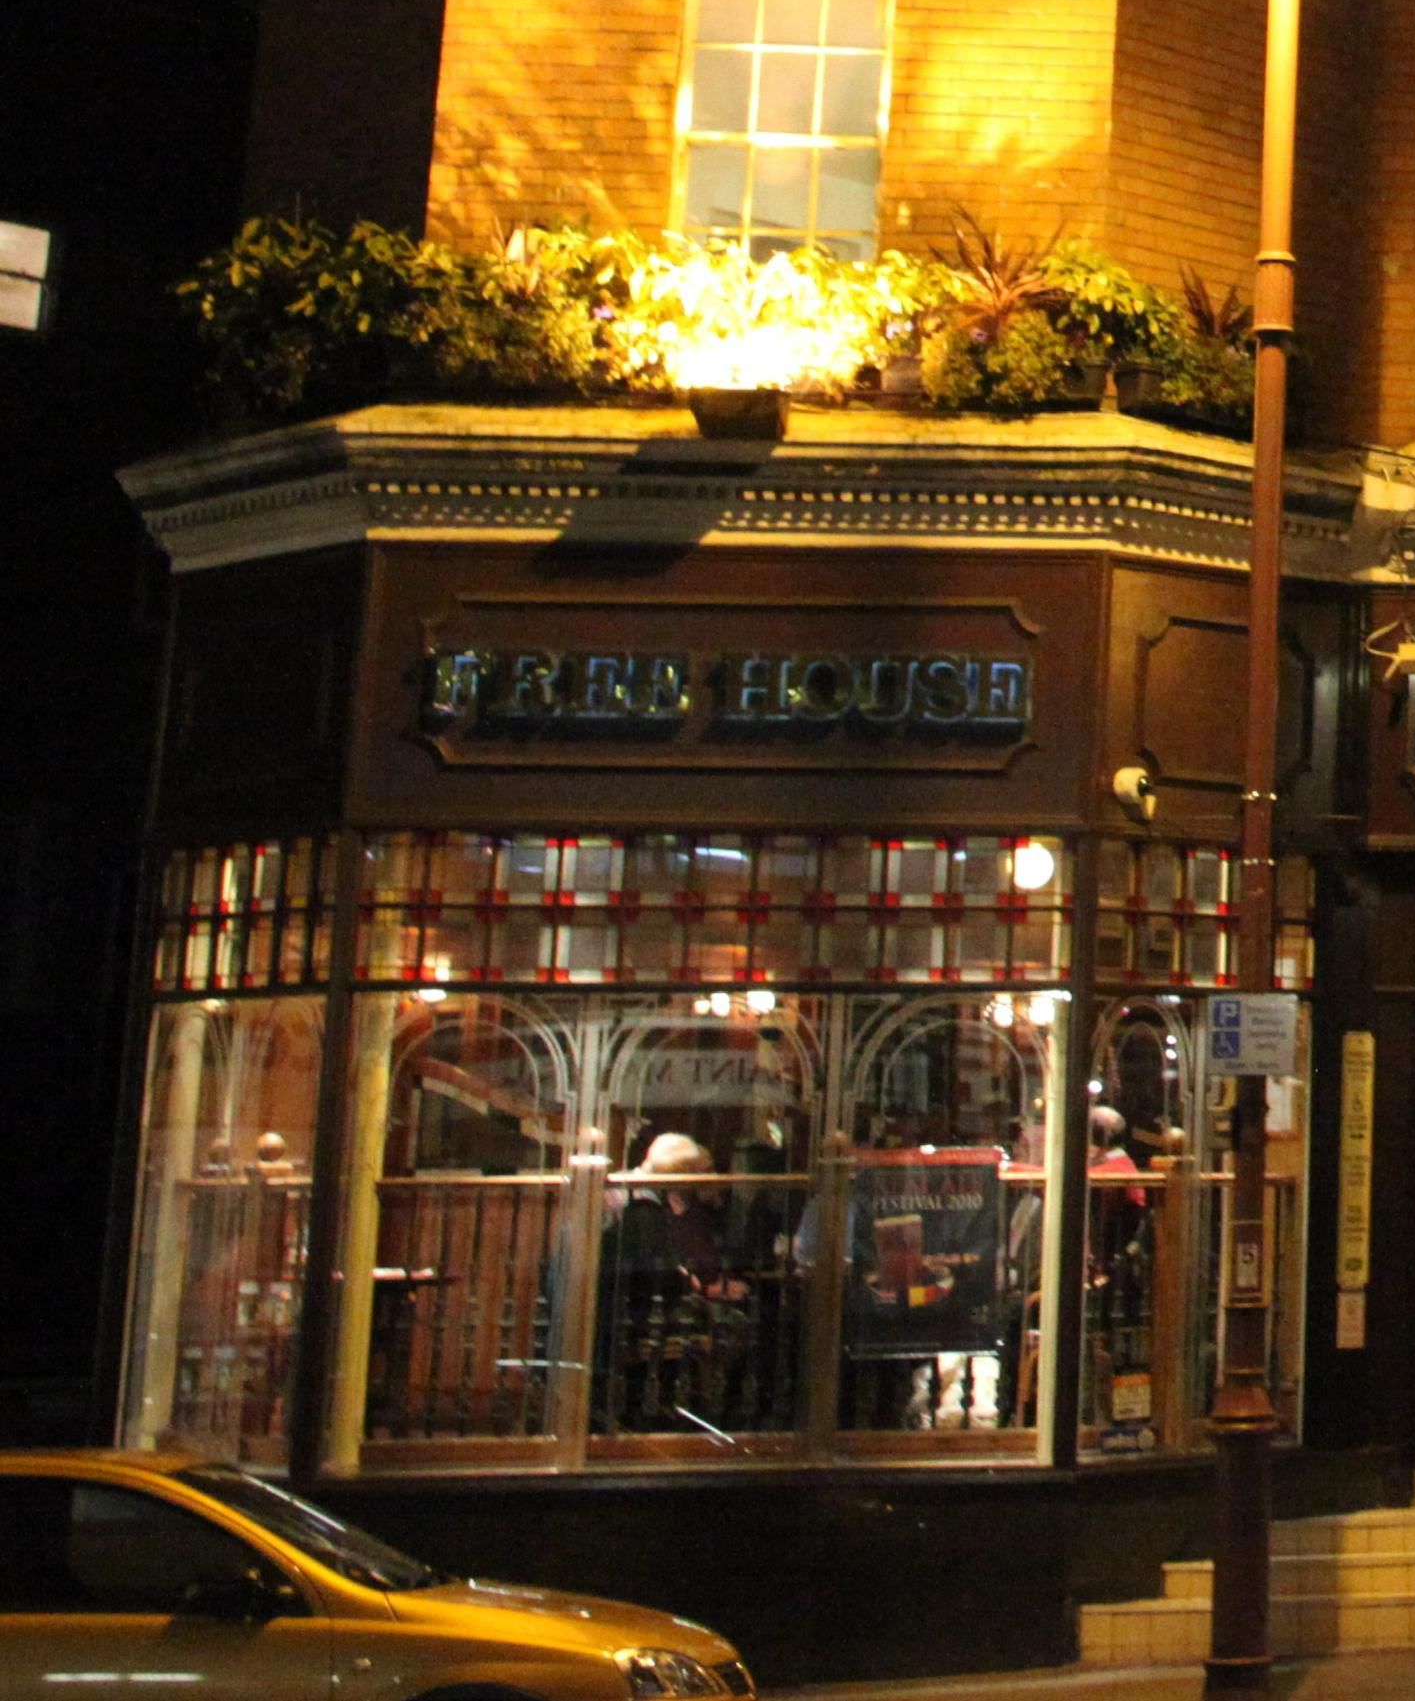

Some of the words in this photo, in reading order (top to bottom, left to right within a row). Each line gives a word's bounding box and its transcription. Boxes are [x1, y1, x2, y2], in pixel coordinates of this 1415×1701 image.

[434, 650, 690, 720] FREE
[722, 652, 1033, 724] HOUSE
[1218, 1002, 1238, 1026] P
[872, 1193, 943, 1211] FESTIVAL
[946, 1191, 984, 1211] 2010
